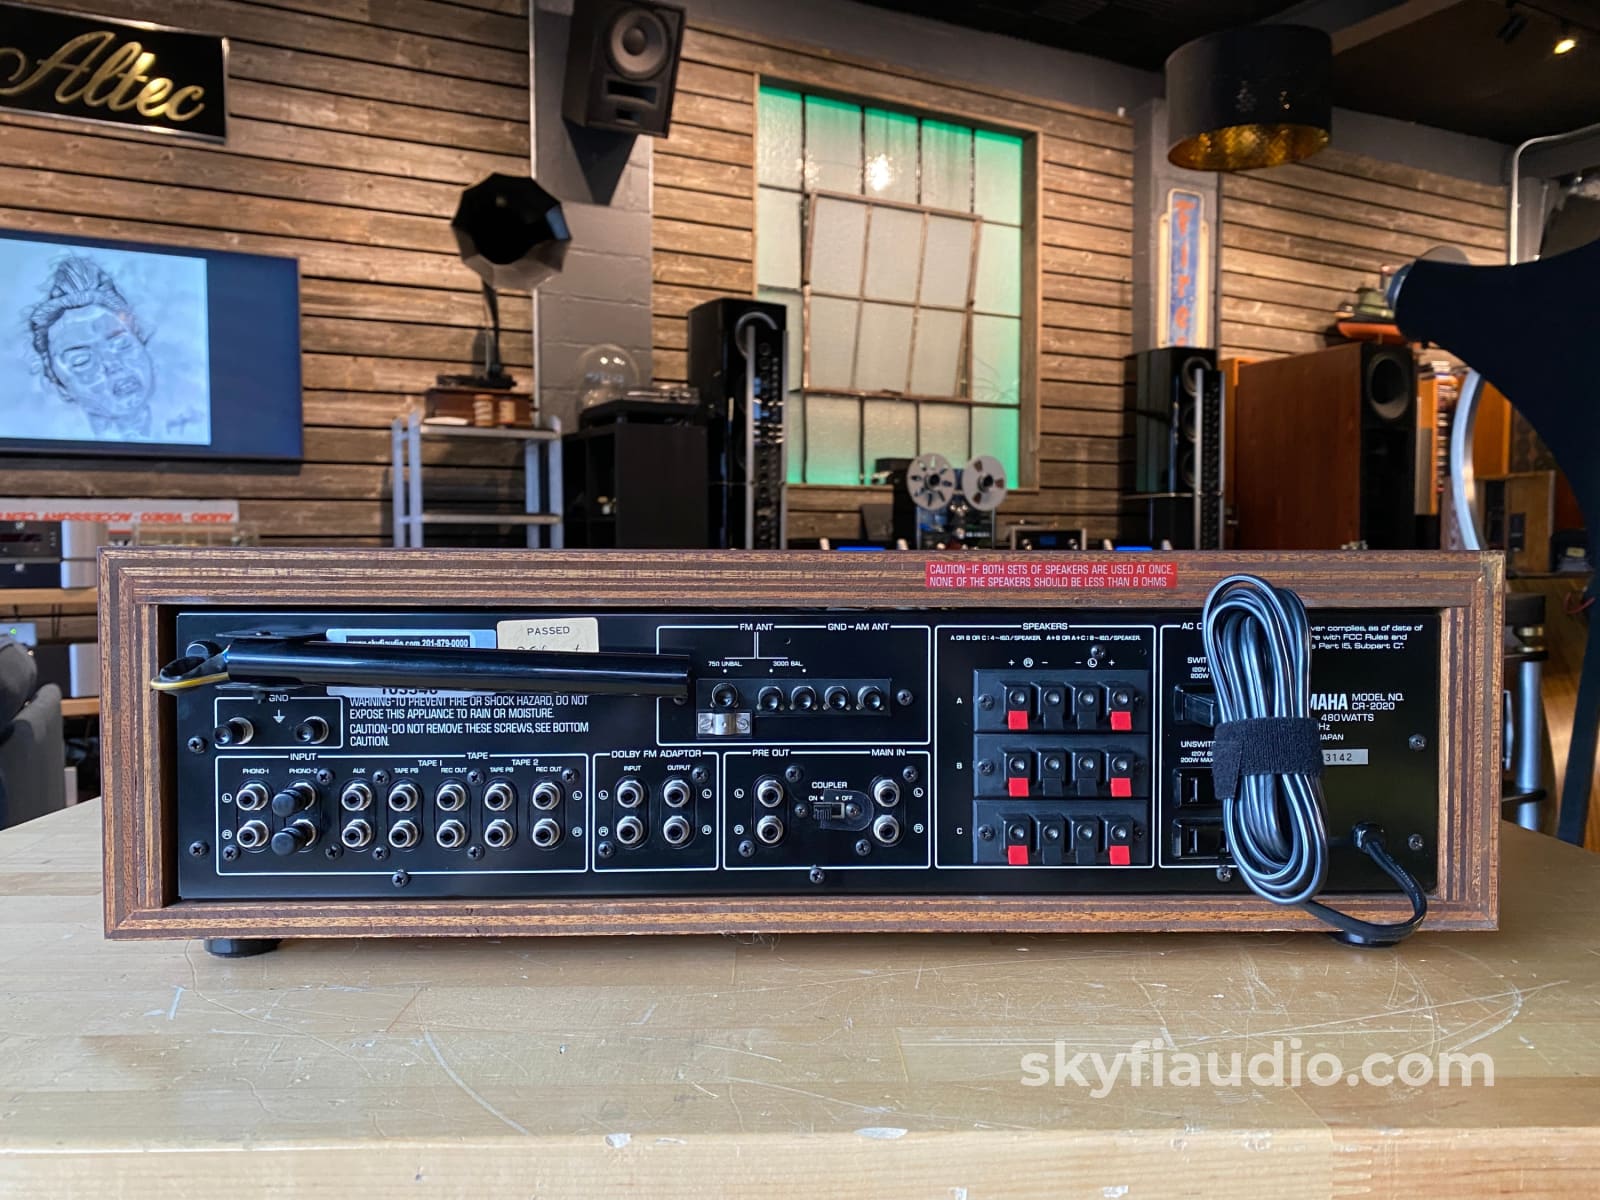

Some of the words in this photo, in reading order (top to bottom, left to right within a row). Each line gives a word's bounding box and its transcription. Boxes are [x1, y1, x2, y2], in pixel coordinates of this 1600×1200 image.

[0, 31, 205, 121] Altec
[982, 564, 1004, 574] BOTH
[1008, 564, 1028, 574] SETS
[1030, 564, 1042, 574] OF
[1045, 564, 1088, 574] SPEAKERS
[1092, 564, 1108, 574] ARE
[1111, 564, 1134, 574] USED
[1136, 564, 1146, 574] AT
[930, 577, 953, 586] NONE
[956, 577, 967, 586] OF
[970, 577, 985, 586] THE
[988, 577, 1030, 586] SPEAKERS
[1034, 577, 1068, 586] SHOULD
[1071, 577, 1081, 586] BE
[1084, 577, 1104, 586] LESS
[1107, 577, 1130, 586] THAN
[1142, 577, 1167, 586] OHMS
[527, 626, 570, 636] PASSED
[422, 638, 468, 647] 201-879-0000
[409, 696, 446, 706] PREVENT
[450, 696, 468, 706] FIRE
[470, 696, 482, 706] OR
[484, 696, 514, 705] SHOCK
[516, 696, 554, 706] HAZARD,
[556, 696, 568, 705] DO
[571, 696, 588, 705] NOT
[1310, 694, 1348, 710] MAHA
[350, 709, 384, 719] EXPOSE
[386, 709, 405, 719] THIS
[407, 709, 454, 719] APPLIANCE
[456, 708, 468, 718] TO
[470, 708, 491, 718] RAIN
[494, 708, 505, 718] OR
[407, 723, 425, 733] NOT
[426, 723, 463, 733] REMOVE
[464, 723, 492, 733] THESE
[553, 722, 588, 732] BOTTOM
[1326, 753, 1352, 761] 3142
